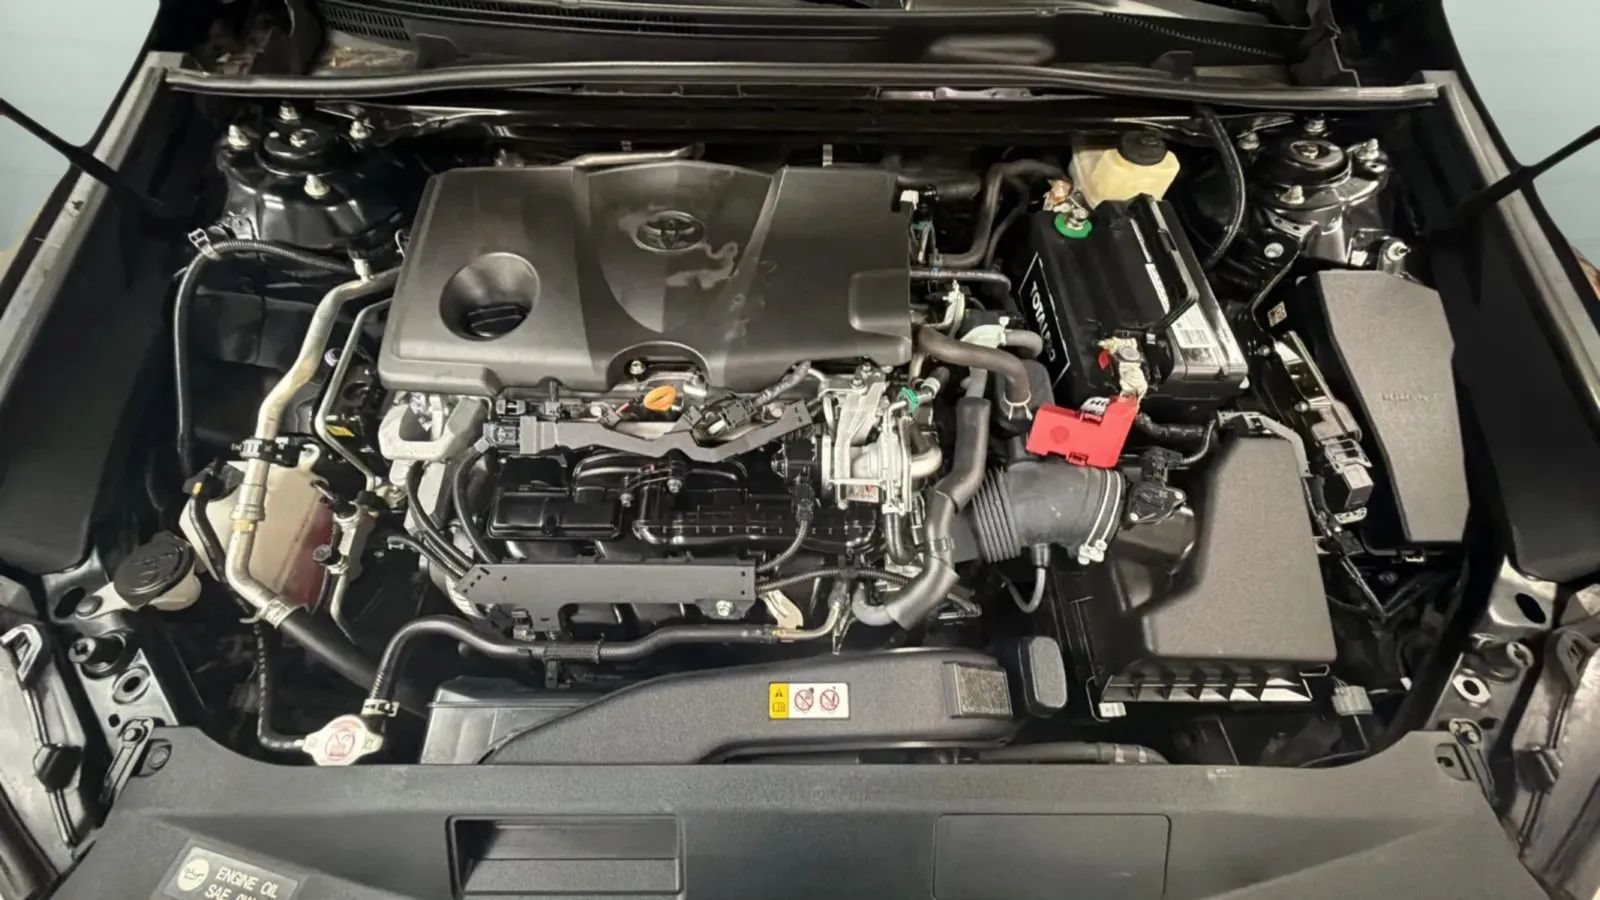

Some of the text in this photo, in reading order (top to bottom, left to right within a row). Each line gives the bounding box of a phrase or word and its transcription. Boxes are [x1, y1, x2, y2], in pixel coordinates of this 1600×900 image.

[204, 883, 232, 900] SAE
[215, 866, 279, 899] ENGINE OIL
